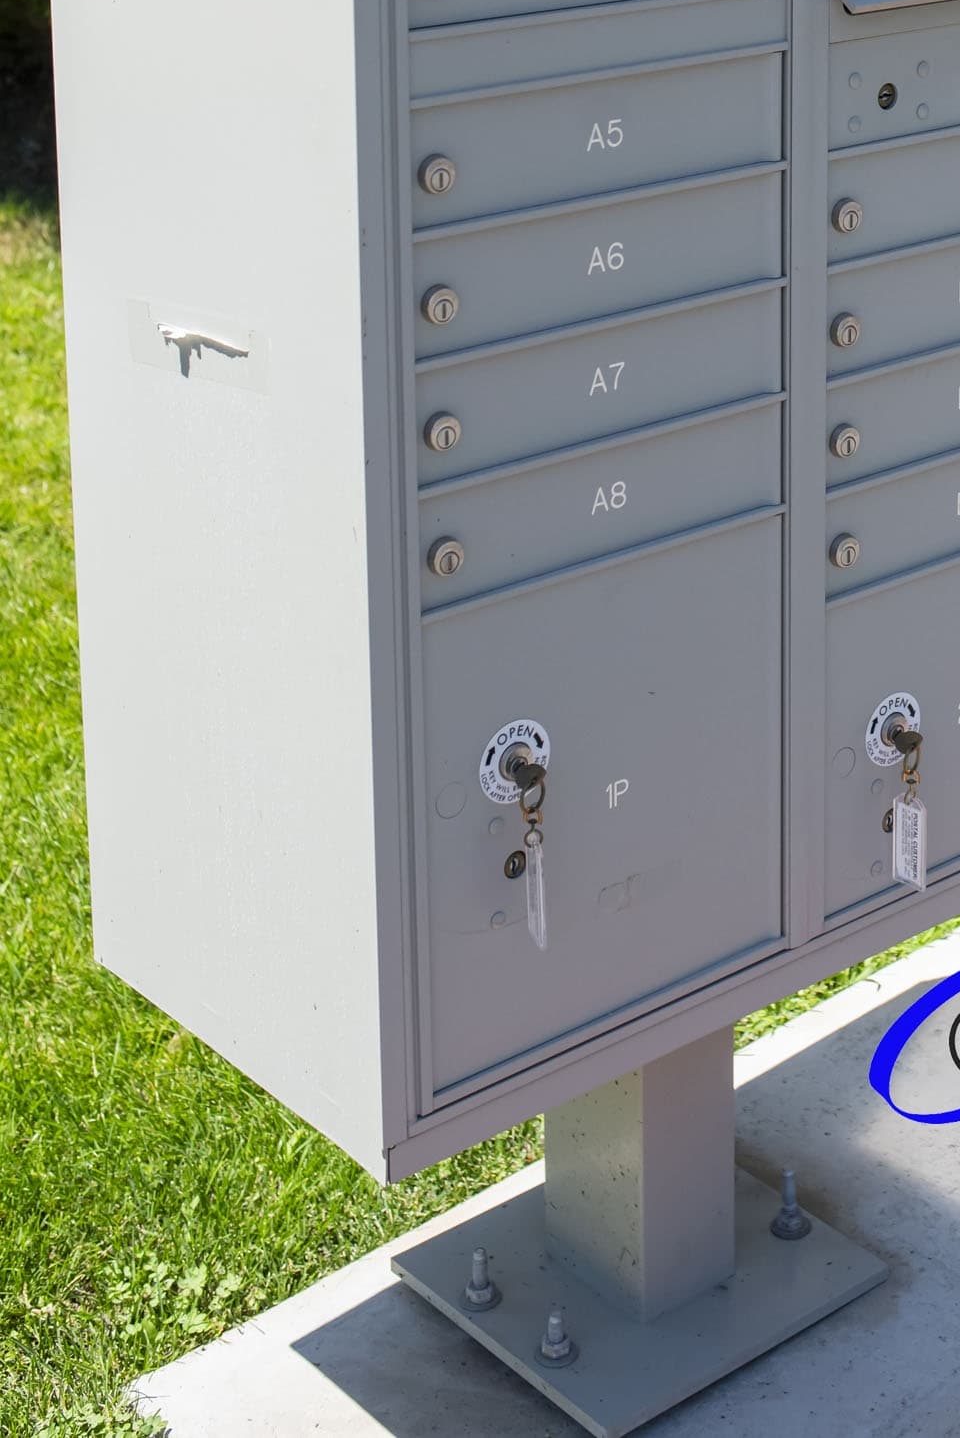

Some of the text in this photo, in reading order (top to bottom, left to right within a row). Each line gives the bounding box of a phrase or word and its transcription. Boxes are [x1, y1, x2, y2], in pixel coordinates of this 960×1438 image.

[587, 119, 623, 151] A5
[588, 242, 624, 275] A6
[590, 362, 624, 396] A7
[592, 481, 626, 515] A8
[879, 697, 908, 716] OPEN
[497, 725, 535, 746] OPEN
[481, 773, 506, 802] LOCK AFTER
[496, 784, 510, 793] WILL
[606, 778, 629, 809] 1P
